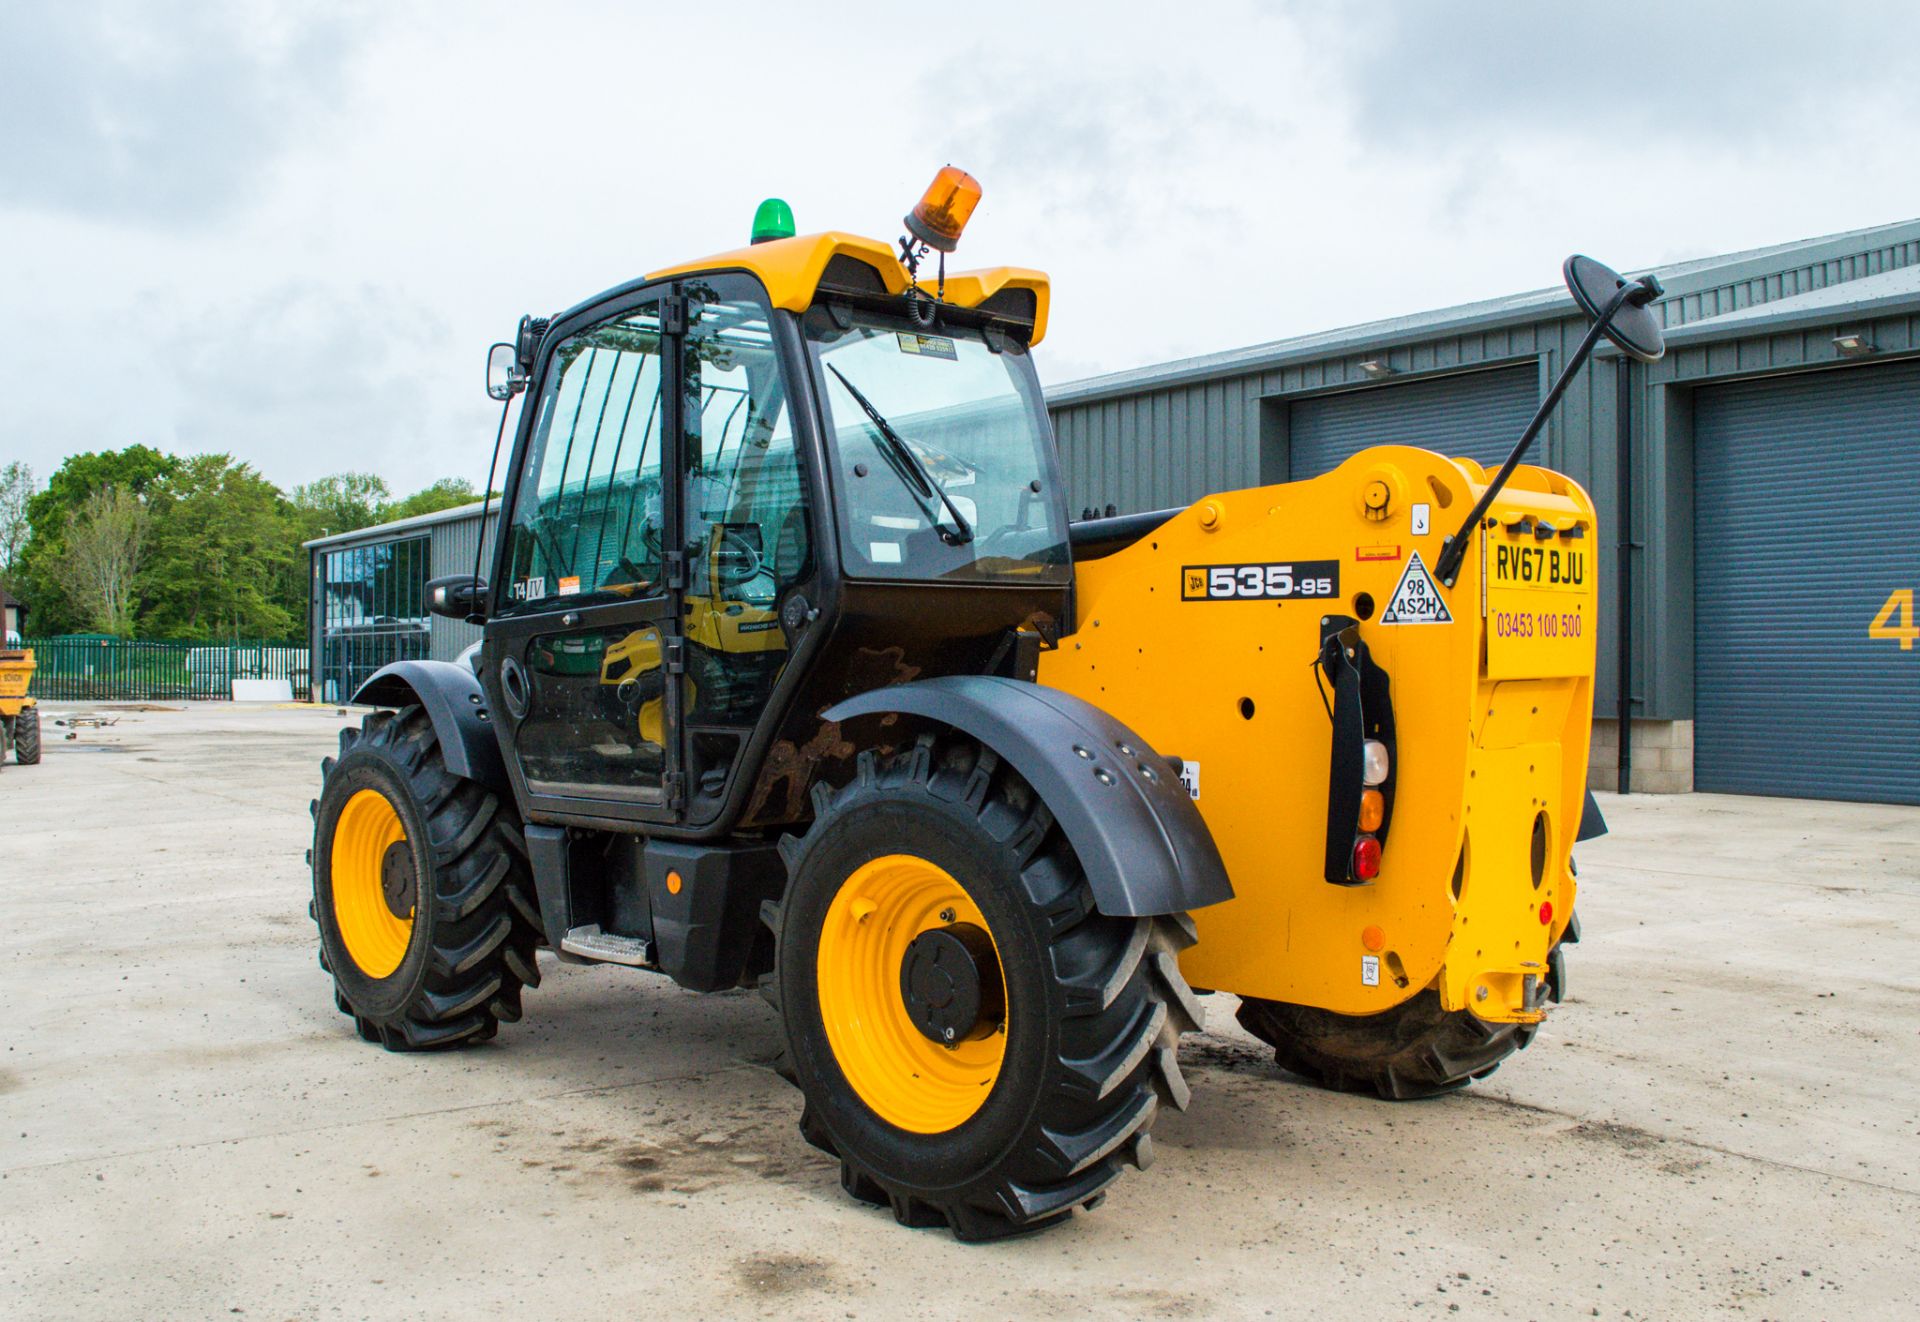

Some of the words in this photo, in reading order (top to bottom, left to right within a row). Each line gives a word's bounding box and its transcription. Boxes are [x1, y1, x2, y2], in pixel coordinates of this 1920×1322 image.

[1497, 545, 1543, 582] RV67
[1550, 550, 1583, 585] BJU
[529, 580, 542, 597] IV
[1407, 579, 1425, 595] 98
[1398, 598, 1436, 614] AS2H
[1497, 612, 1533, 637] 03453
[1537, 613, 1558, 637] 100
[1562, 614, 1581, 637] 500
[1868, 589, 1920, 650] 4
